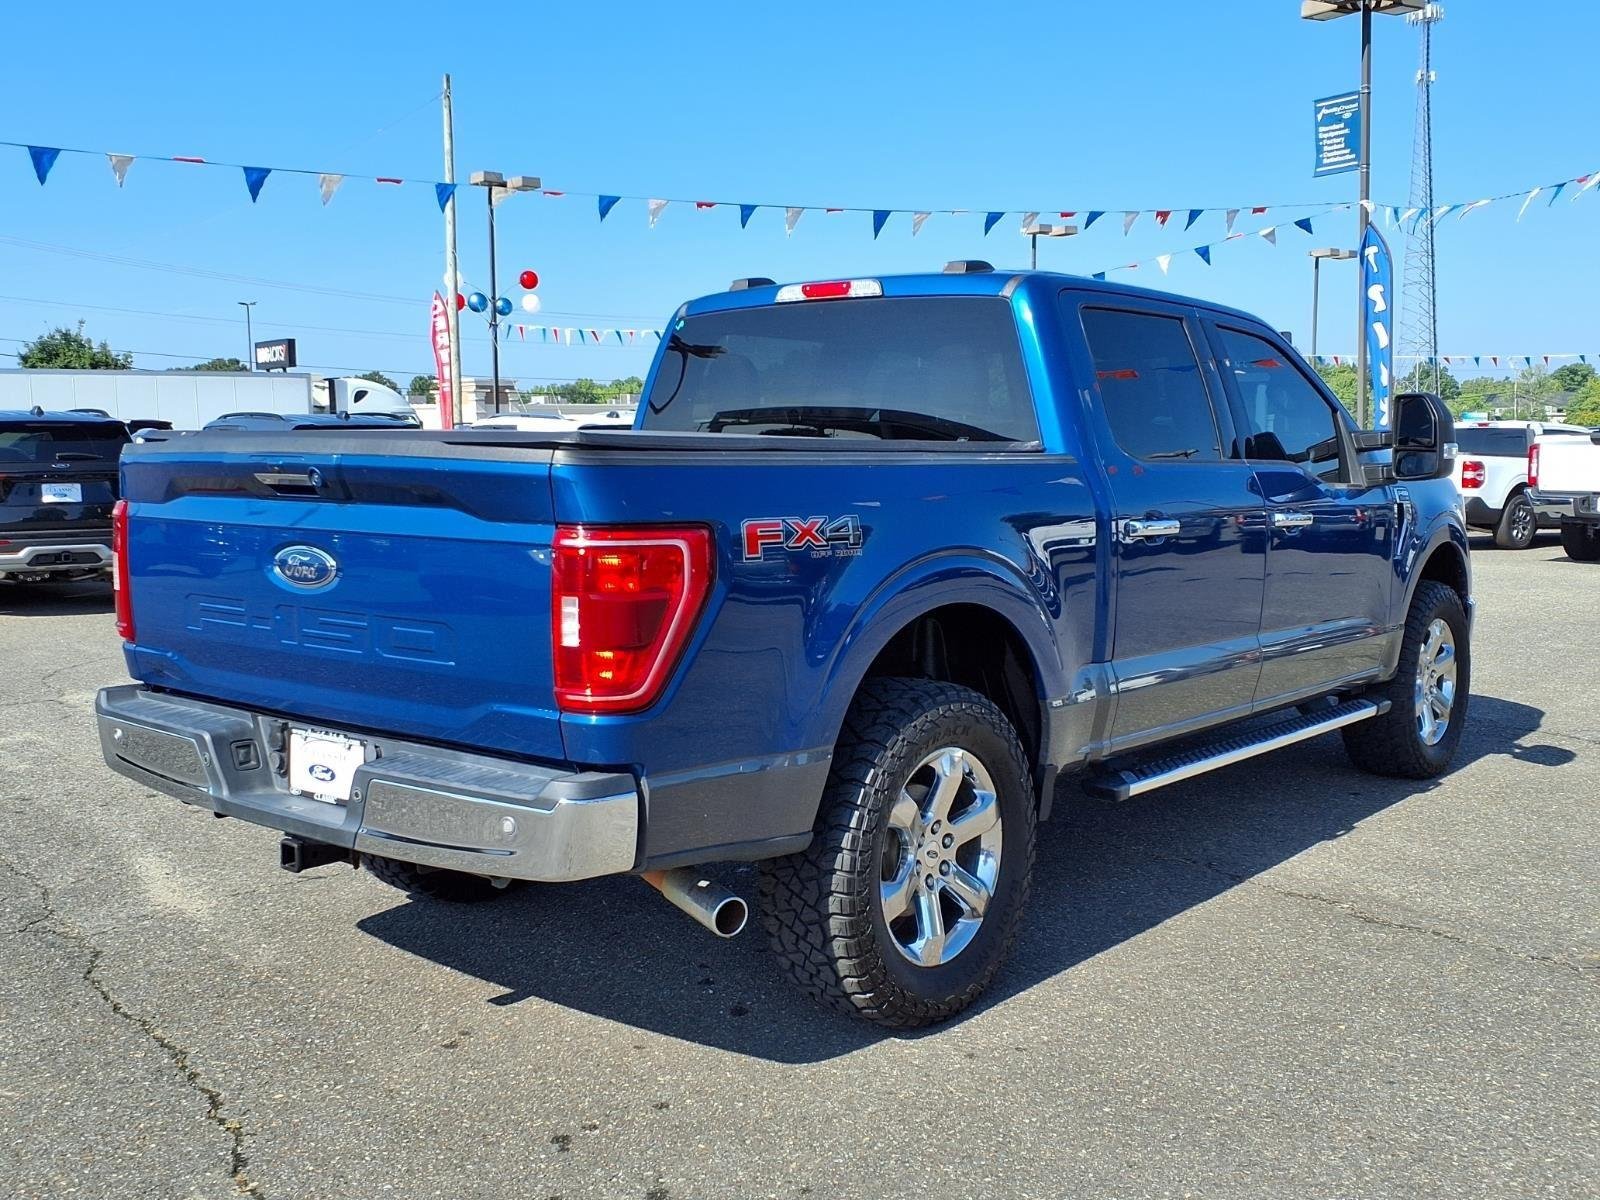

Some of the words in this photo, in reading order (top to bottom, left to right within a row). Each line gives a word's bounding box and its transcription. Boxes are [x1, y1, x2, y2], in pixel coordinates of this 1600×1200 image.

[741, 515, 862, 562] FX4
[284, 554, 319, 579] Ford
[184, 593, 456, 666] F-150
